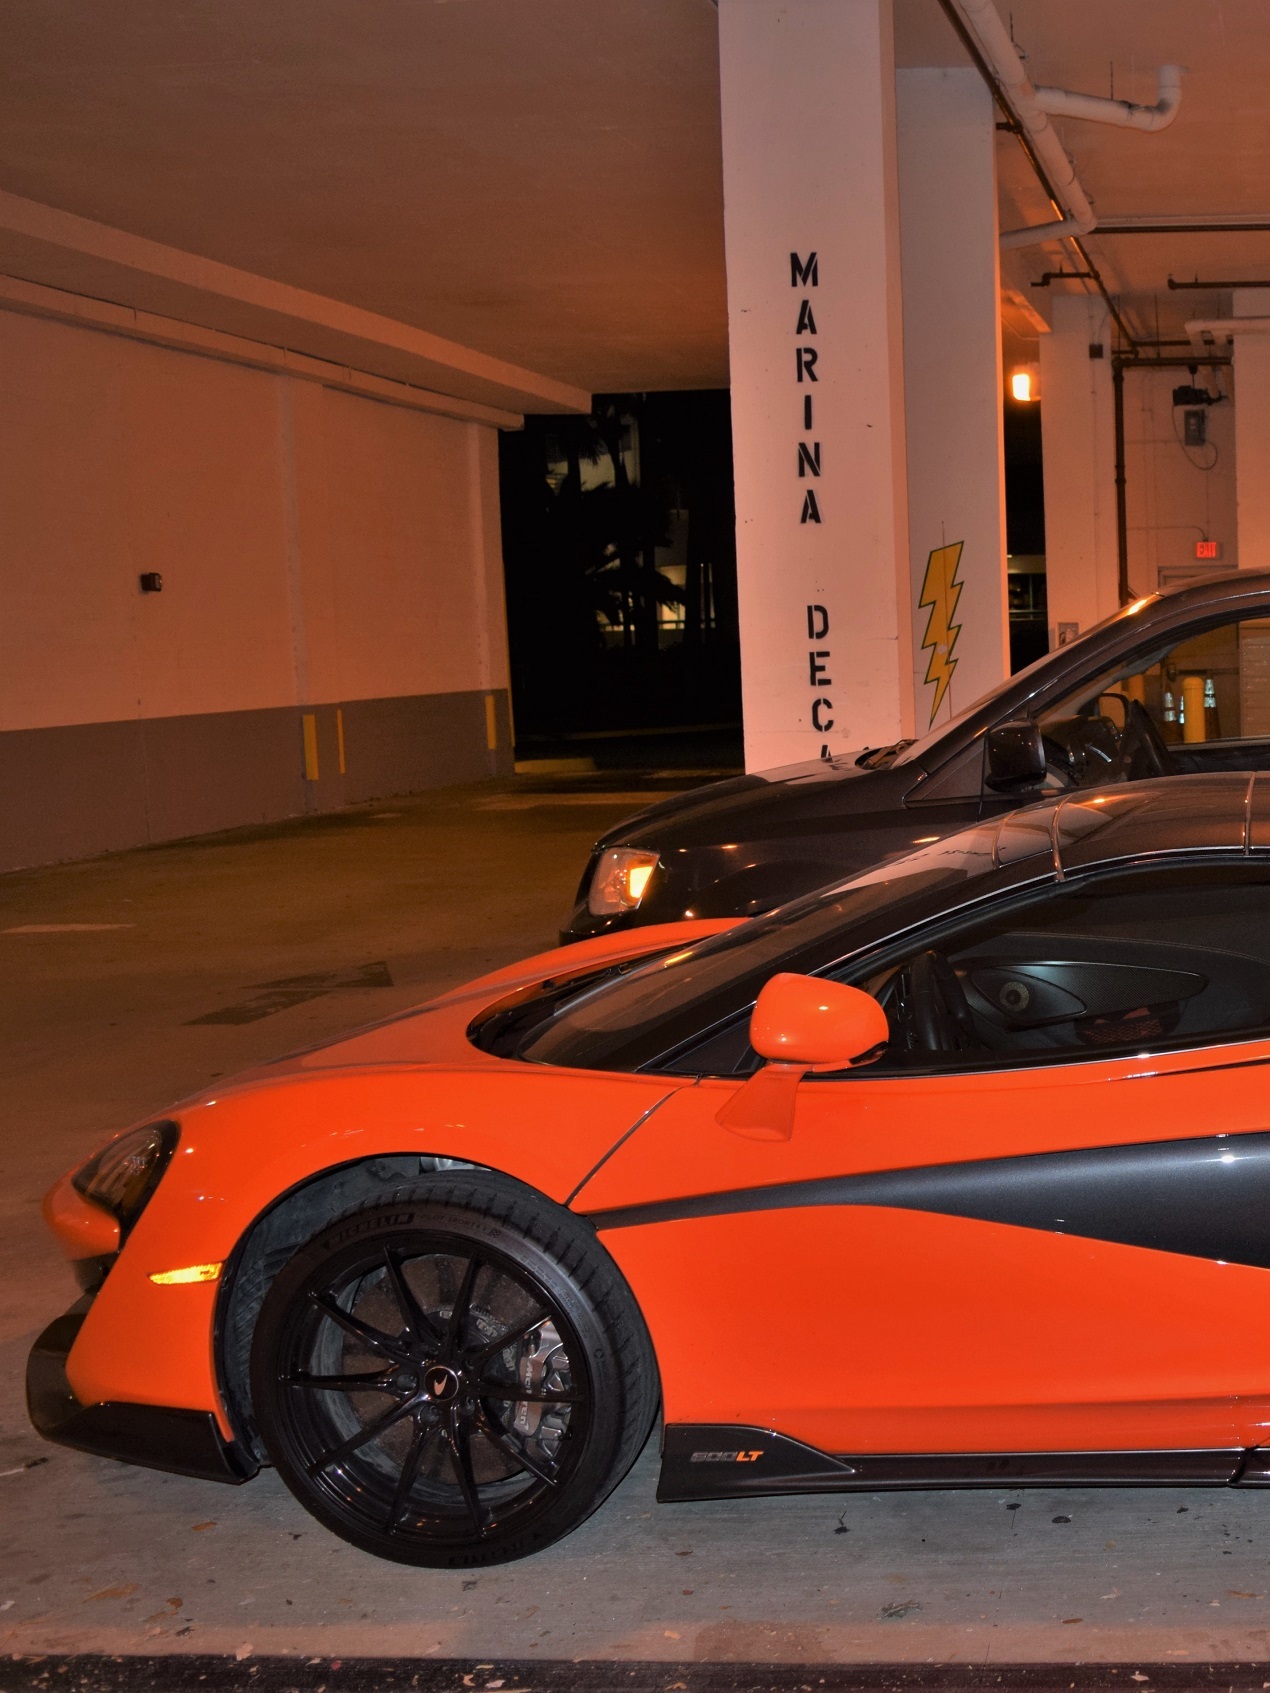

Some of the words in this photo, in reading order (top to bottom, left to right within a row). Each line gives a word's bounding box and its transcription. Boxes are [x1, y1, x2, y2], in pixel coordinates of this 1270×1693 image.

[790, 251, 823, 524] MARINA
[1198, 542, 1217, 558] EXIT
[520, 1361, 534, 1425] Mcren
[690, 1450, 765, 1463] 600LT
